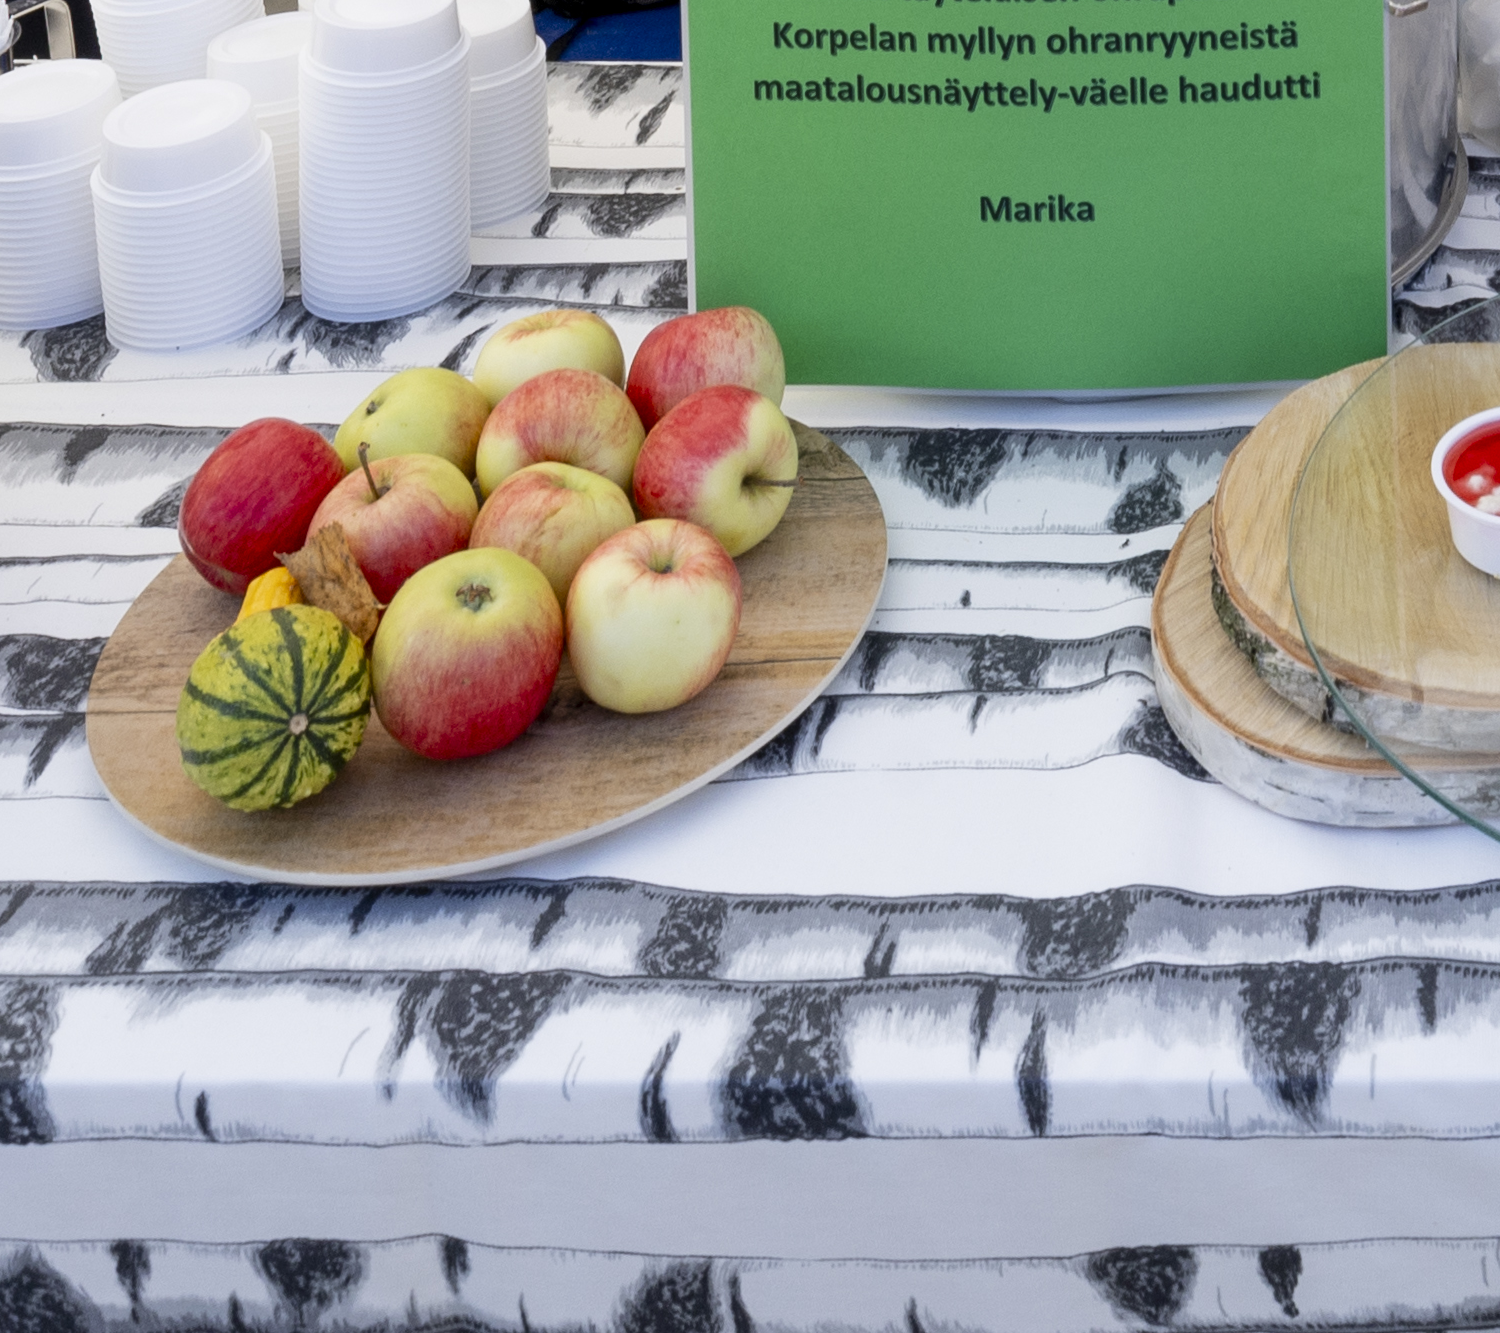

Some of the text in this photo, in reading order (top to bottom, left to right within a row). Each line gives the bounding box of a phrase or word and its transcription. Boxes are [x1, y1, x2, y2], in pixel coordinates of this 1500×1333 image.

[773, 20, 1299, 61] Korpelan myllyn ohranryyneistä
[753, 71, 1321, 114] maatalousnäyttely-väelle haudutti
[979, 193, 1096, 223] Marika
